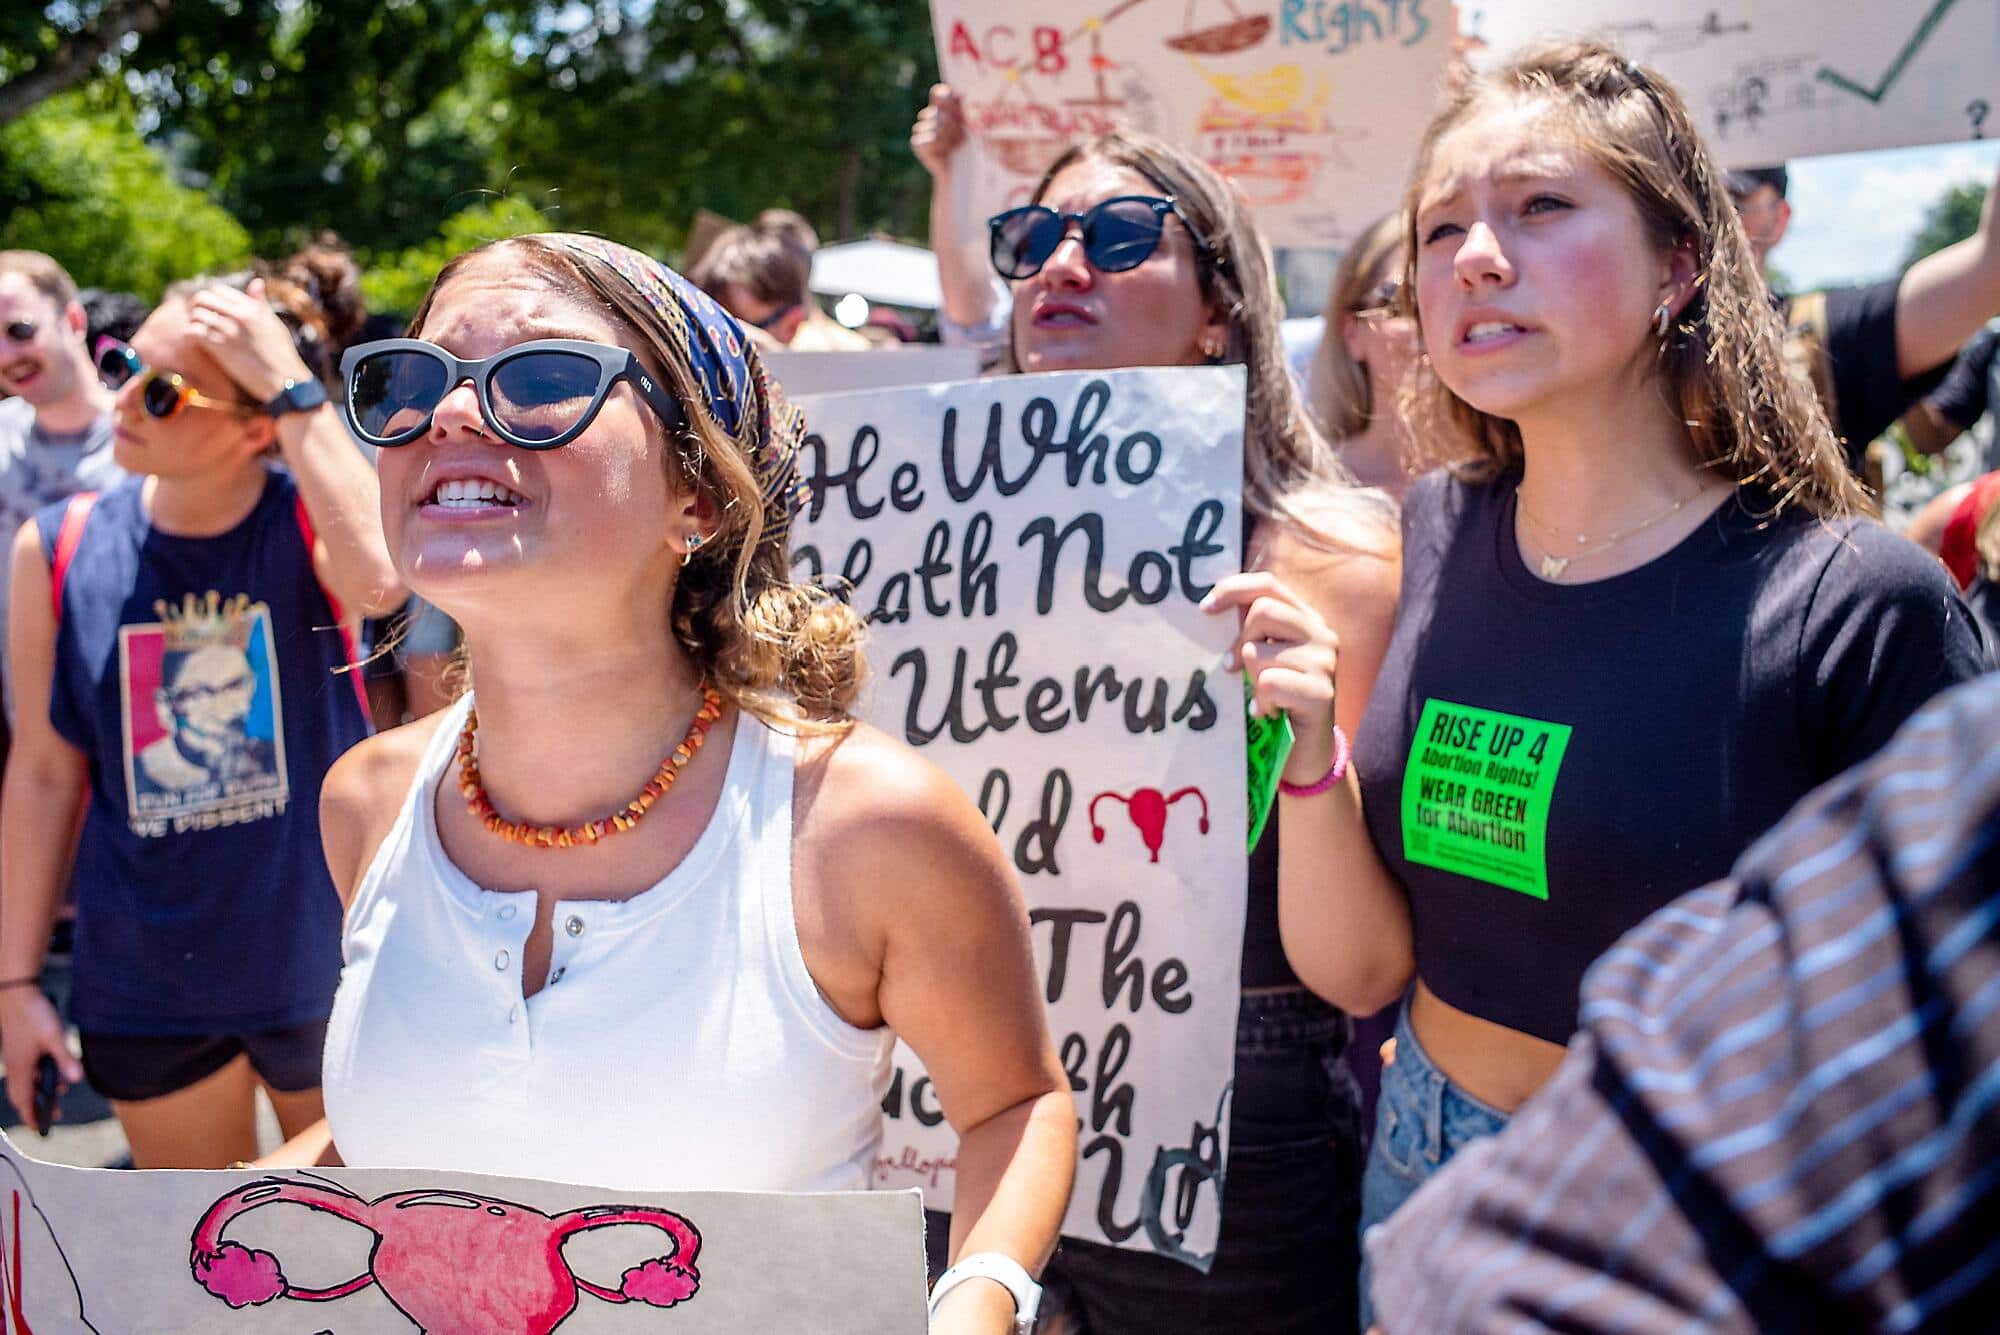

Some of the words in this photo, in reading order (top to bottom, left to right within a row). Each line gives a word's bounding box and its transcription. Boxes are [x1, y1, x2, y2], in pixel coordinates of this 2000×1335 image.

[801, 425, 924, 523] He
[942, 379, 1162, 502] Who
[1018, 499, 1225, 615] Not
[890, 631, 1218, 746] Uterus
[1421, 747, 1482, 775] Abortion
[1485, 761, 1539, 790] Rights!
[1429, 712, 1485, 751] RISE
[1489, 724, 1524, 758] UP
[1528, 732, 1549, 765] 4
[1416, 802, 1440, 829] for
[1448, 809, 1526, 853] Abortion
[1420, 775, 1467, 809] WEAR
[1472, 788, 1528, 824] GREEN
[1030, 900, 1192, 1014] The
